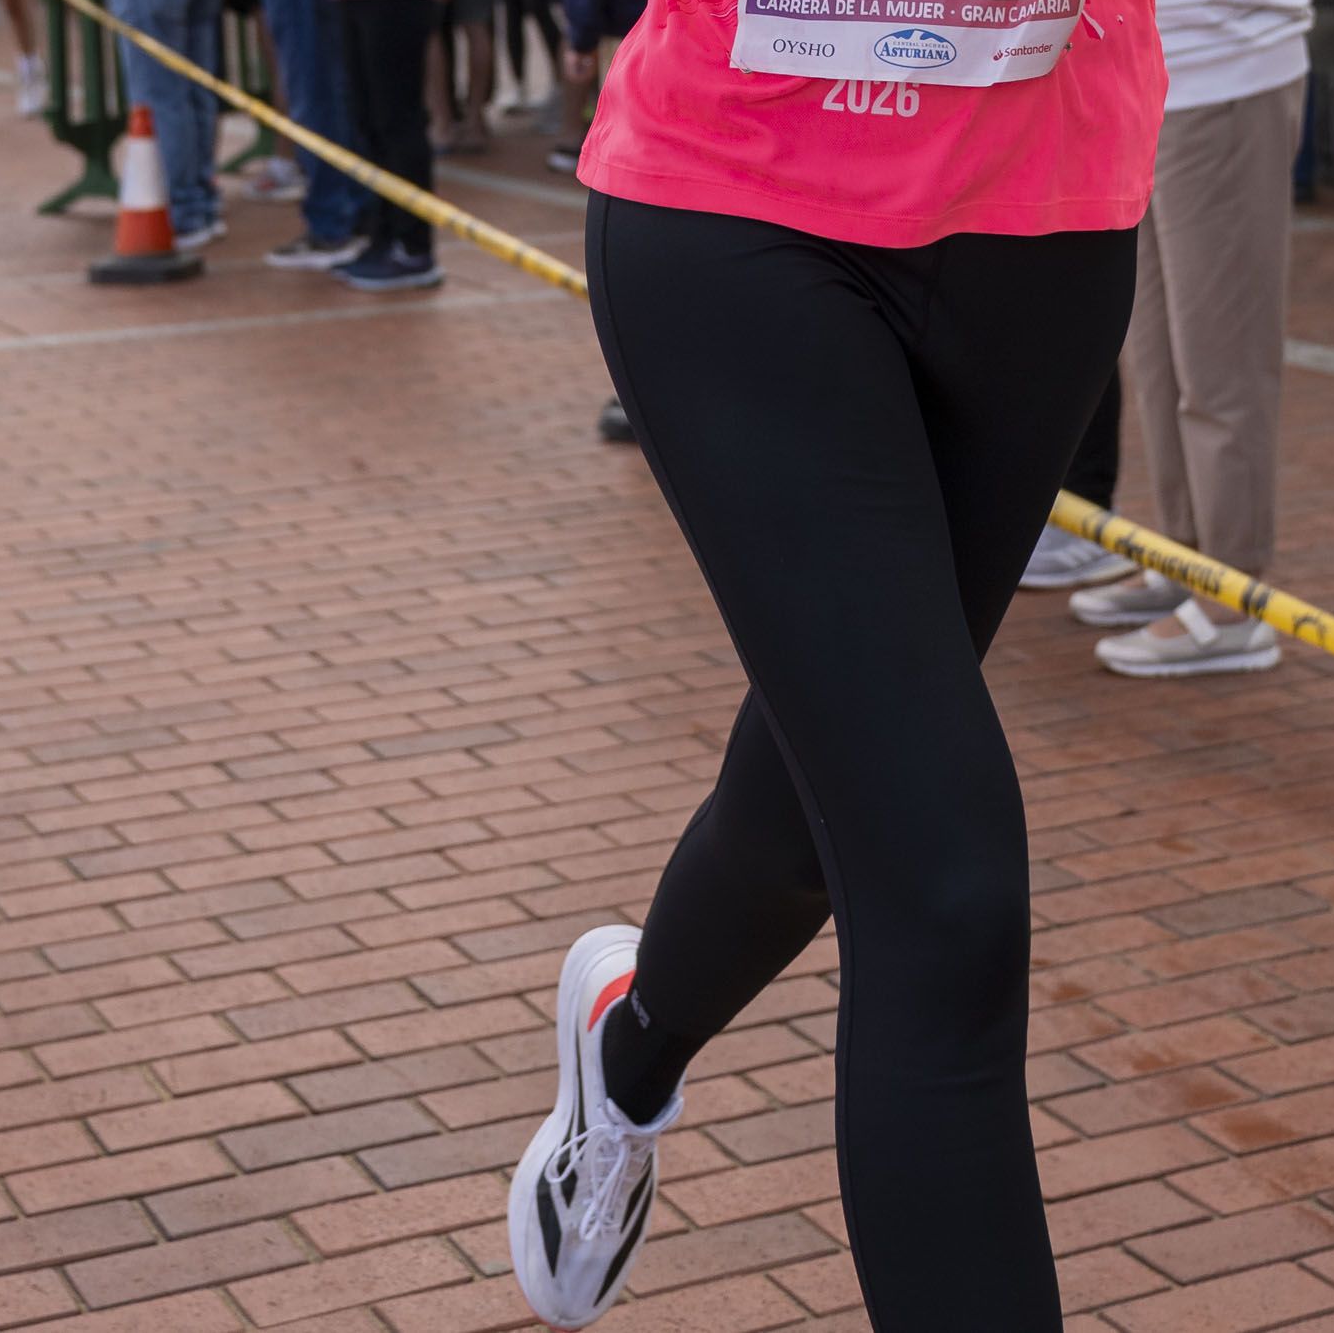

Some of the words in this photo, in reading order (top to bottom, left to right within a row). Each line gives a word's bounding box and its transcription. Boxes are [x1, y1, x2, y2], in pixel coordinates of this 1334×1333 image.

[860, 0, 880, 16] LA
[886, 0, 944, 19] MUJER
[961, 5, 1005, 23] GRAN
[773, 37, 835, 58] OYSHO
[880, 41, 950, 60] ASTURIANA
[1004, 44, 1053, 57] Santander
[822, 80, 920, 117] 2026
